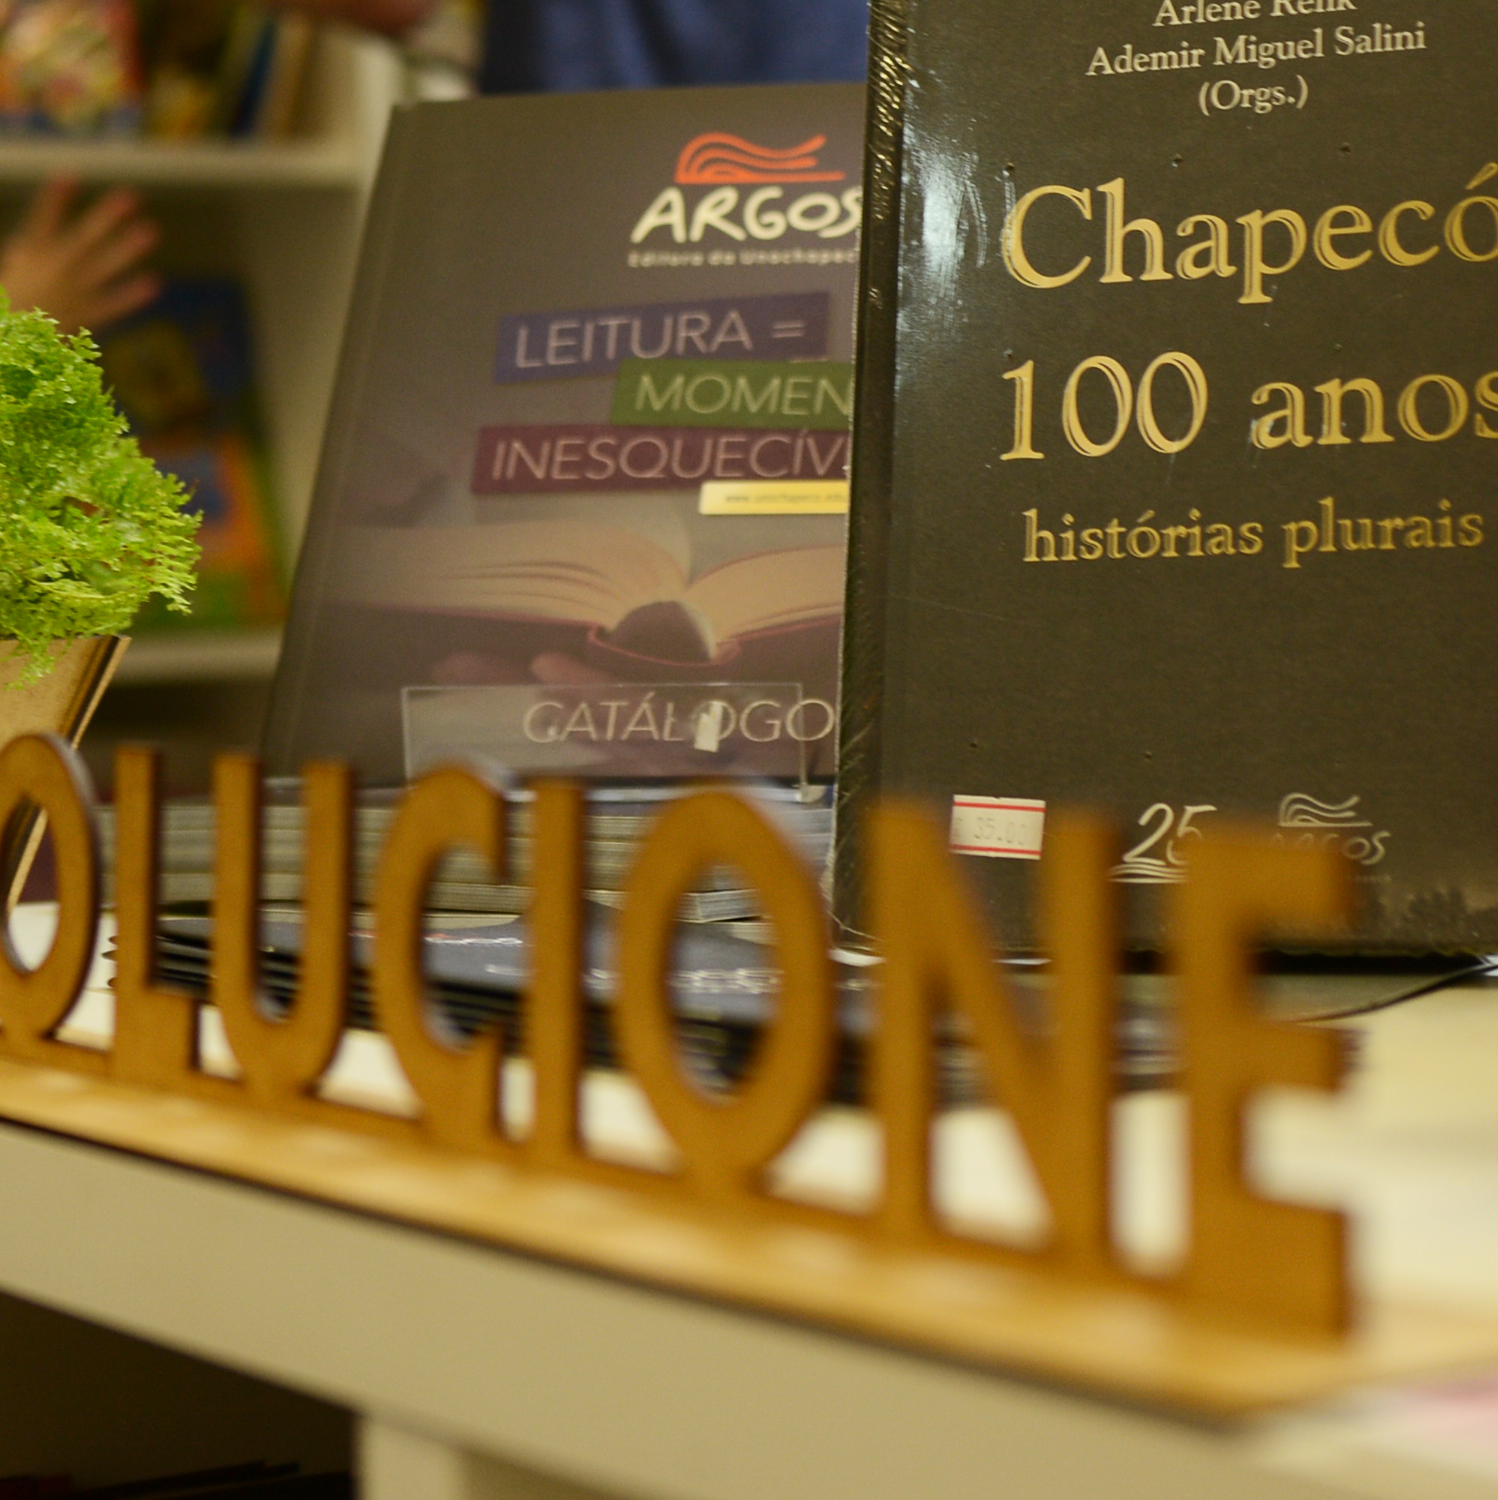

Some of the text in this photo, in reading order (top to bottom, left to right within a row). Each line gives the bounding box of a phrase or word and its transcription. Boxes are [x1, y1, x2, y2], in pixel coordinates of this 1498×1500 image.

[1085, 22, 1427, 77] Ademir Miguel Salini
[1198, 75, 1309, 116] (Orgs.)
[629, 185, 863, 244] ARGOS
[739, 246, 859, 267] Unochapec
[515, 310, 753, 369] LEITURA
[1000, 351, 1209, 461] 100
[490, 427, 850, 482] INESQUECÍV
[1022, 497, 1485, 568] histórias plurais
[521, 691, 837, 745] CATÁLOGO
